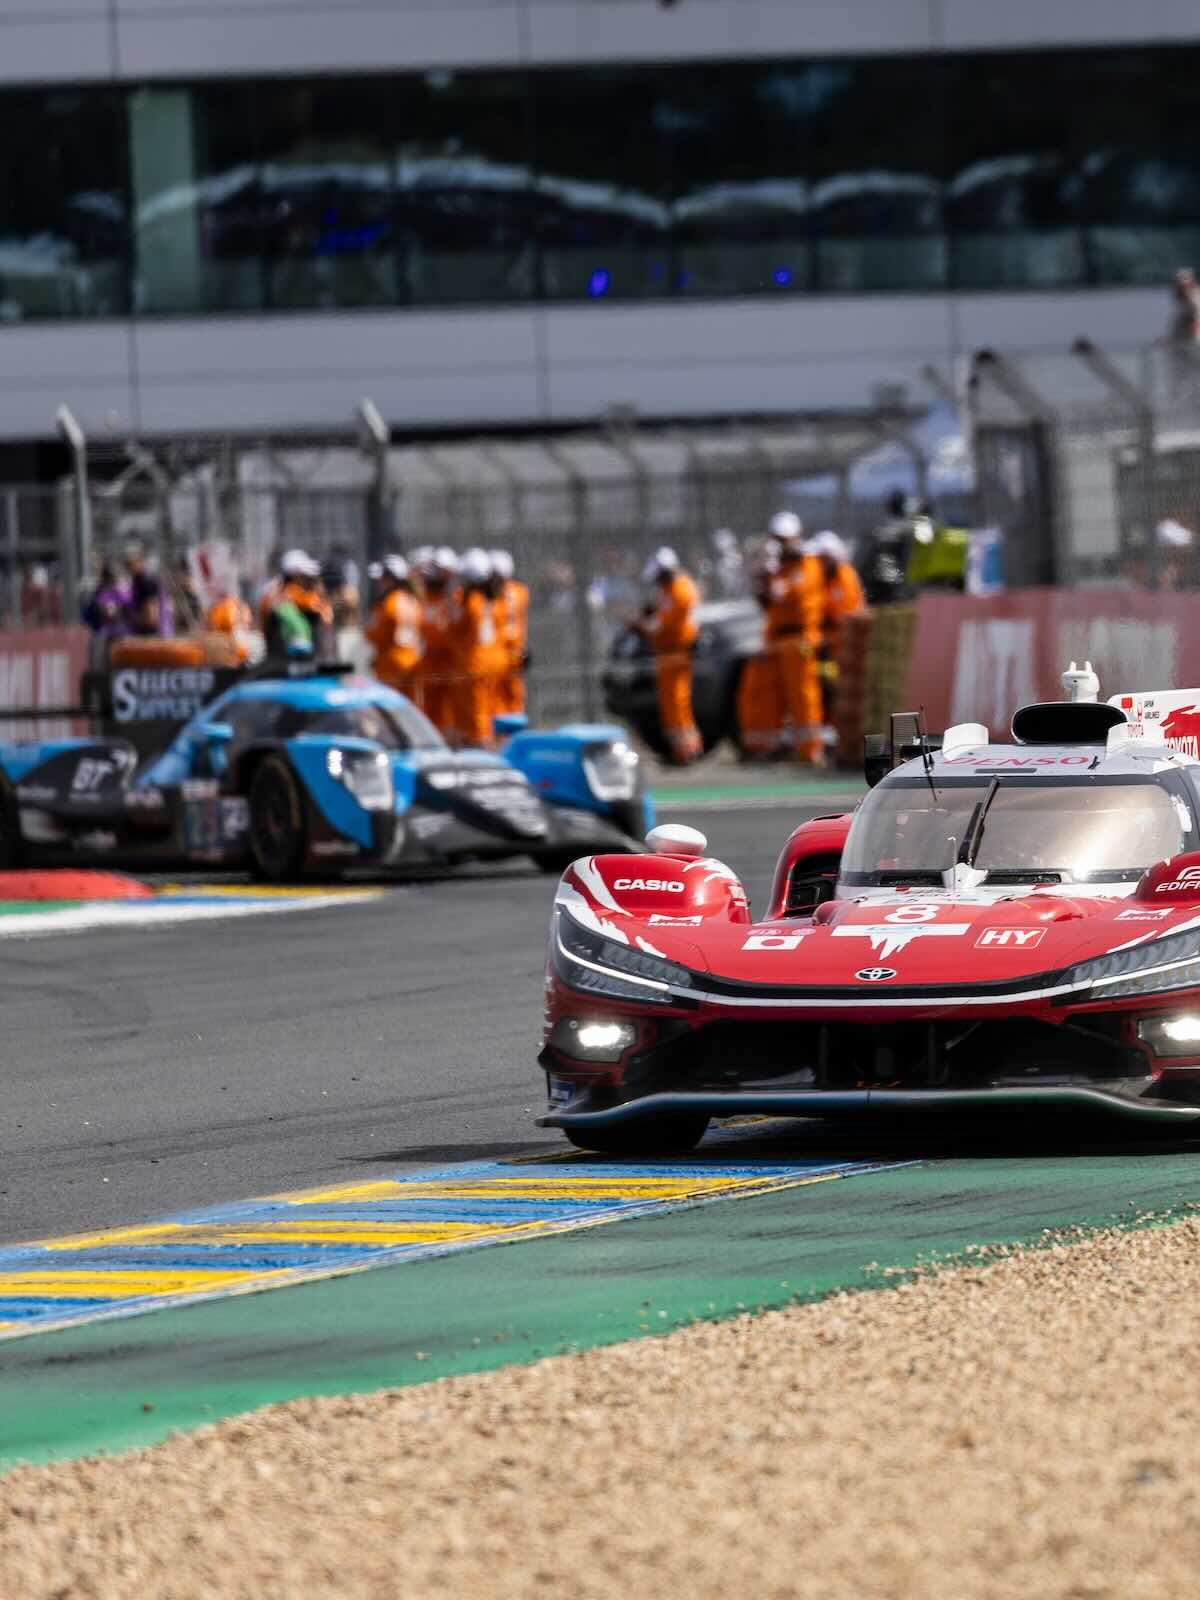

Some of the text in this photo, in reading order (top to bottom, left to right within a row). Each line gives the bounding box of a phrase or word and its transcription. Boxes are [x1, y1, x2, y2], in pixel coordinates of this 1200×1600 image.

[943, 756, 1090, 766] DENSO
[613, 878, 685, 893] CASIO
[884, 904, 941, 923] 8
[980, 930, 1039, 945] HY
